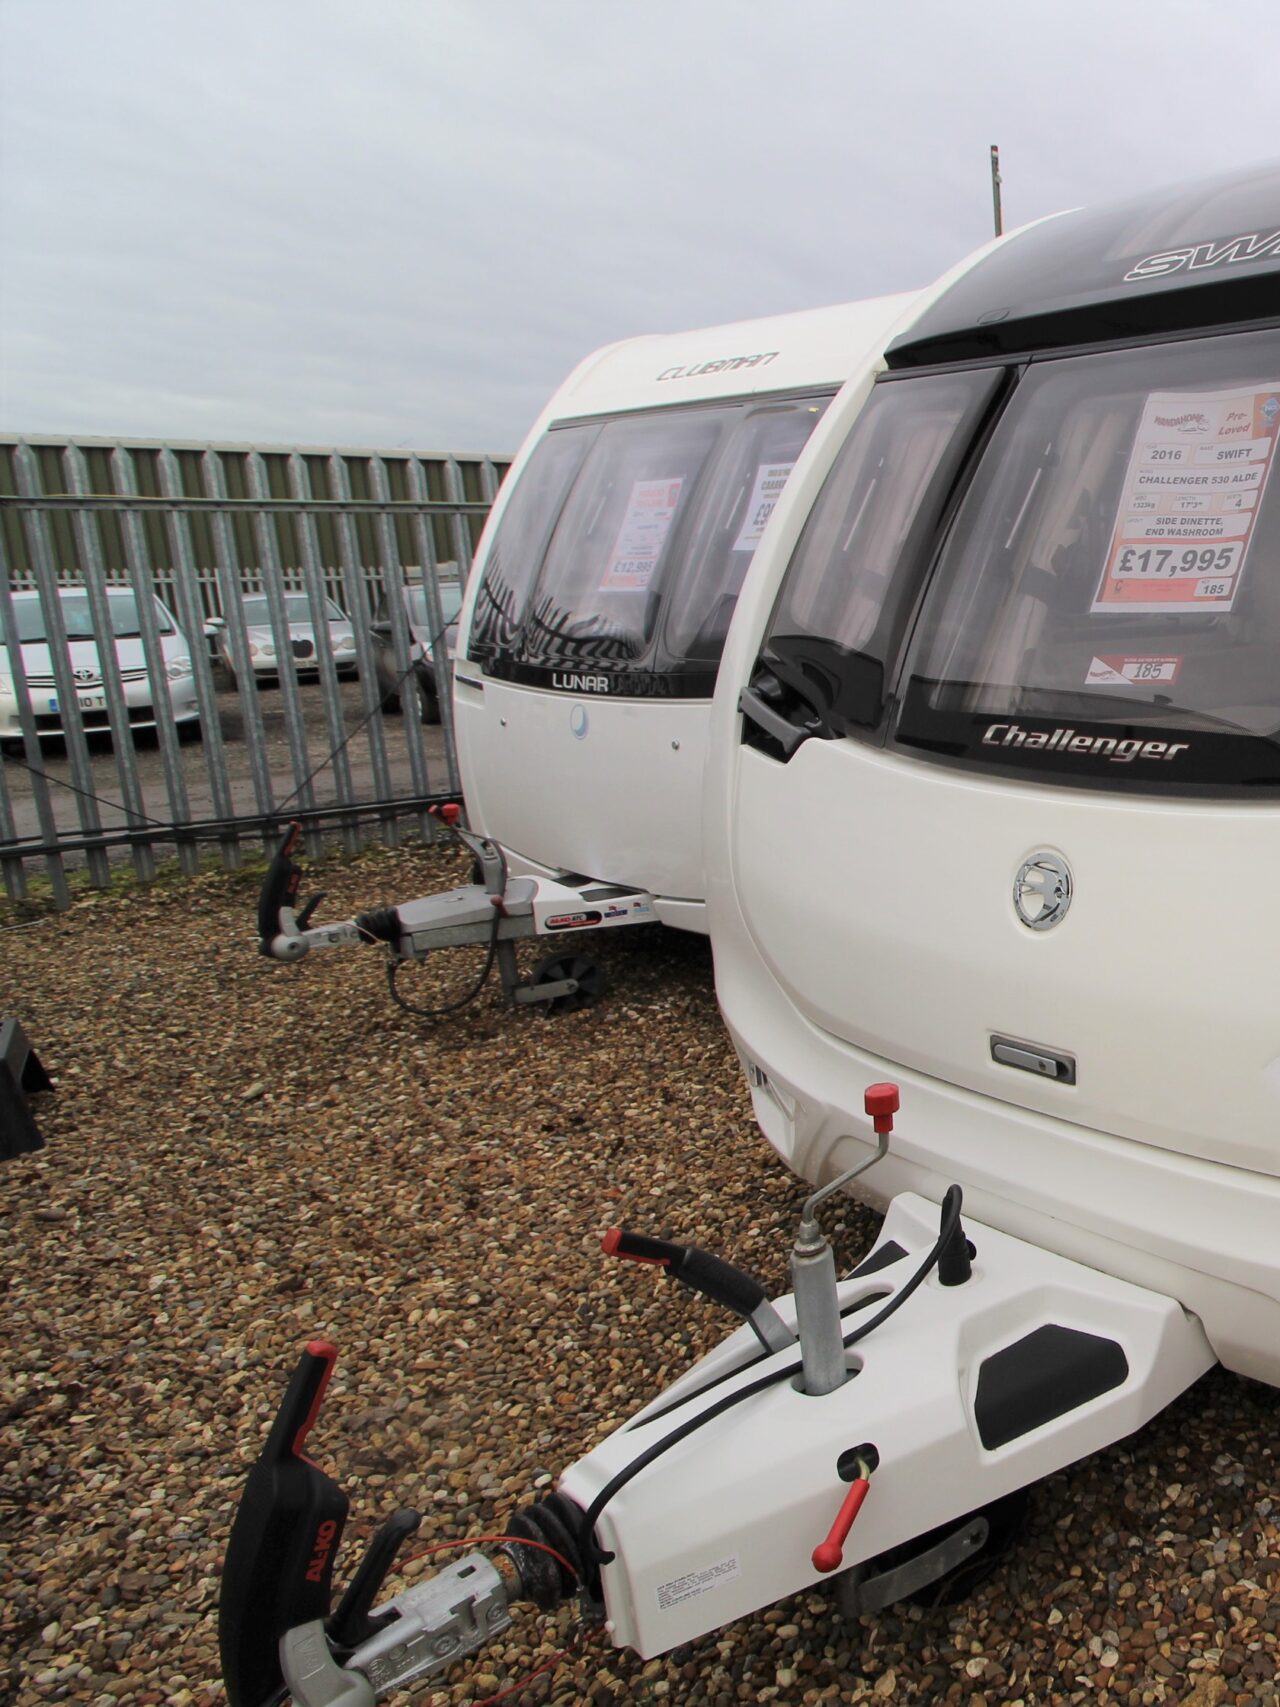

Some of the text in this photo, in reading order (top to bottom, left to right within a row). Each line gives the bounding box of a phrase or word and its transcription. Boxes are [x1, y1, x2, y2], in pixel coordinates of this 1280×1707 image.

[656, 351, 780, 381] CLUBMAN
[1225, 411, 1248, 422] Pre-
[1218, 422, 1251, 436] Loved
[1151, 449, 1182, 461] 2016
[1216, 448, 1253, 461] SWIFT
[1138, 472, 1258, 485] CHALLENGER 530 ALDE
[1234, 498, 1243, 508] 4
[1155, 517, 1177, 526] SIDE
[1145, 528, 1224, 536] END WASHROOM
[1118, 547, 1234, 577] £17,995
[1202, 584, 1225, 595] 185
[1134, 662, 1163, 679] 185
[552, 672, 609, 693] LUNAR
[981, 724, 1190, 763] Challenger
[305, 1519, 337, 1582] AL-KO
